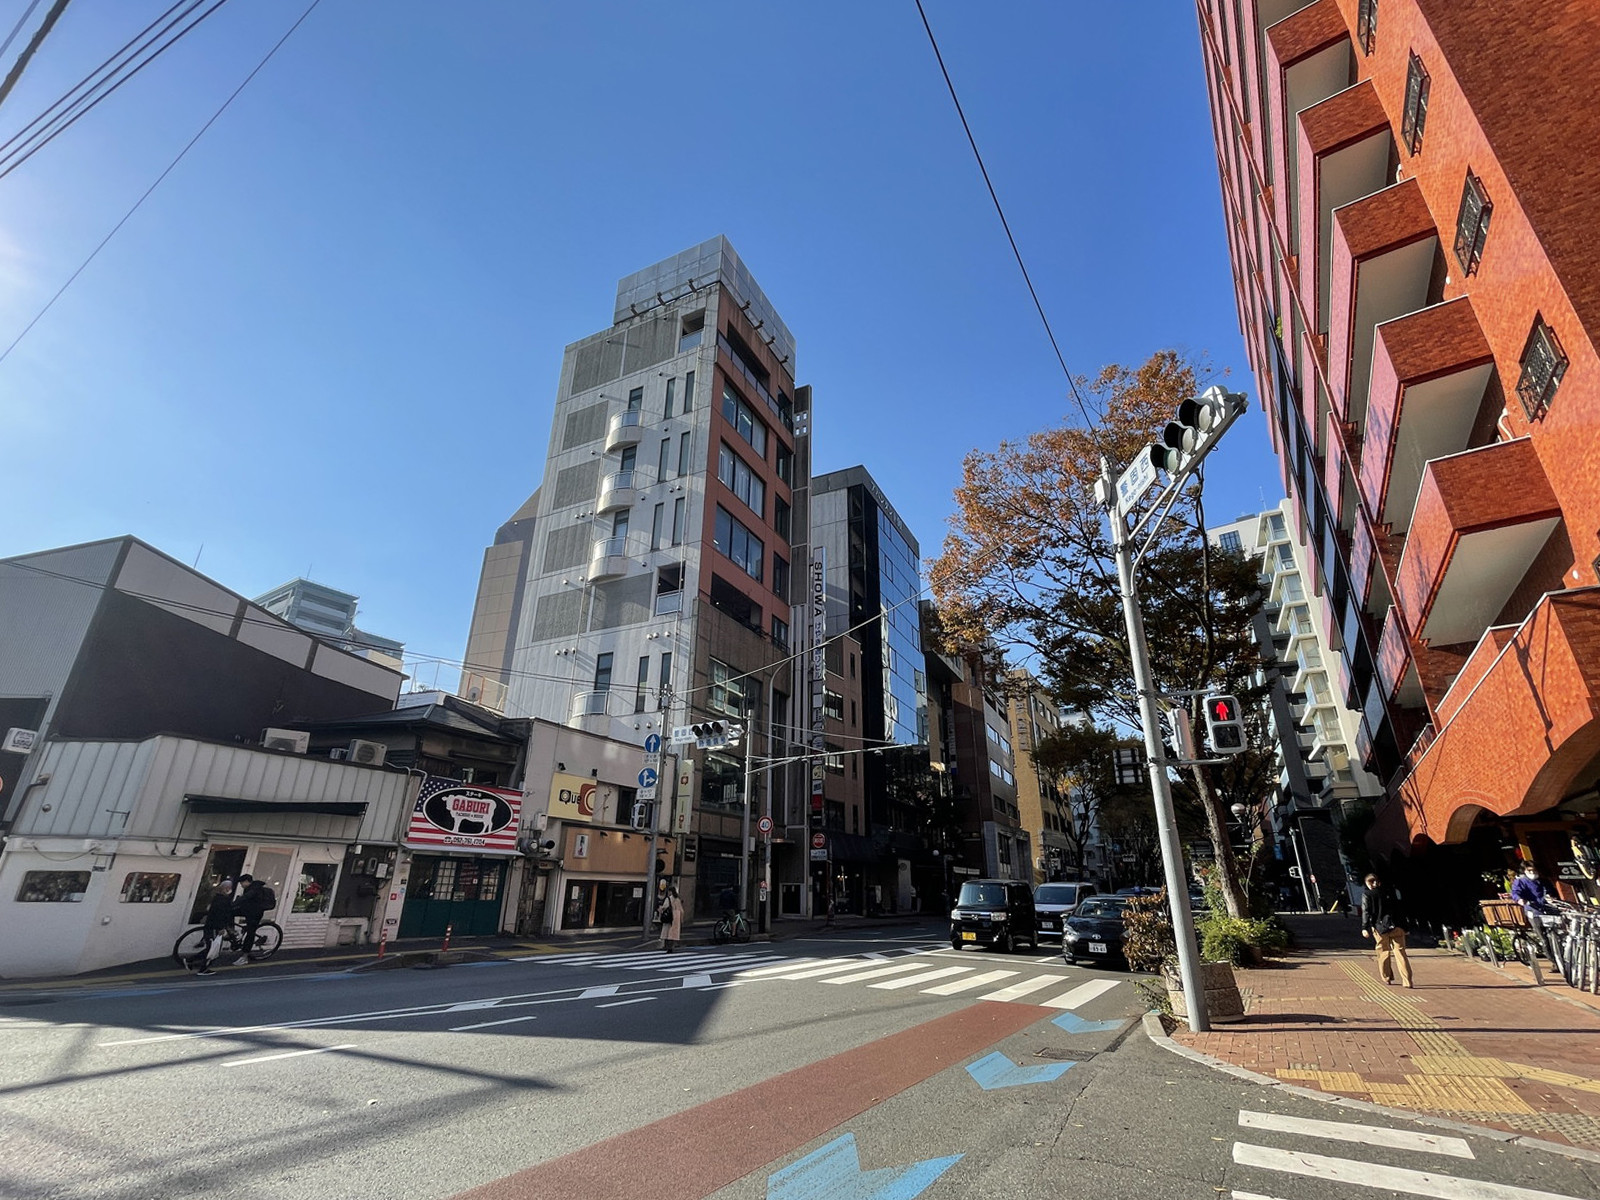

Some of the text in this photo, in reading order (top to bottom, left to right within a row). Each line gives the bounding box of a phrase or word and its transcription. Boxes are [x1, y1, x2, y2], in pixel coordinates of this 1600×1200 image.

[814, 562, 823, 617] SHOWA
[452, 799, 490, 814] GABURI
[761, 821, 770, 829] 40
